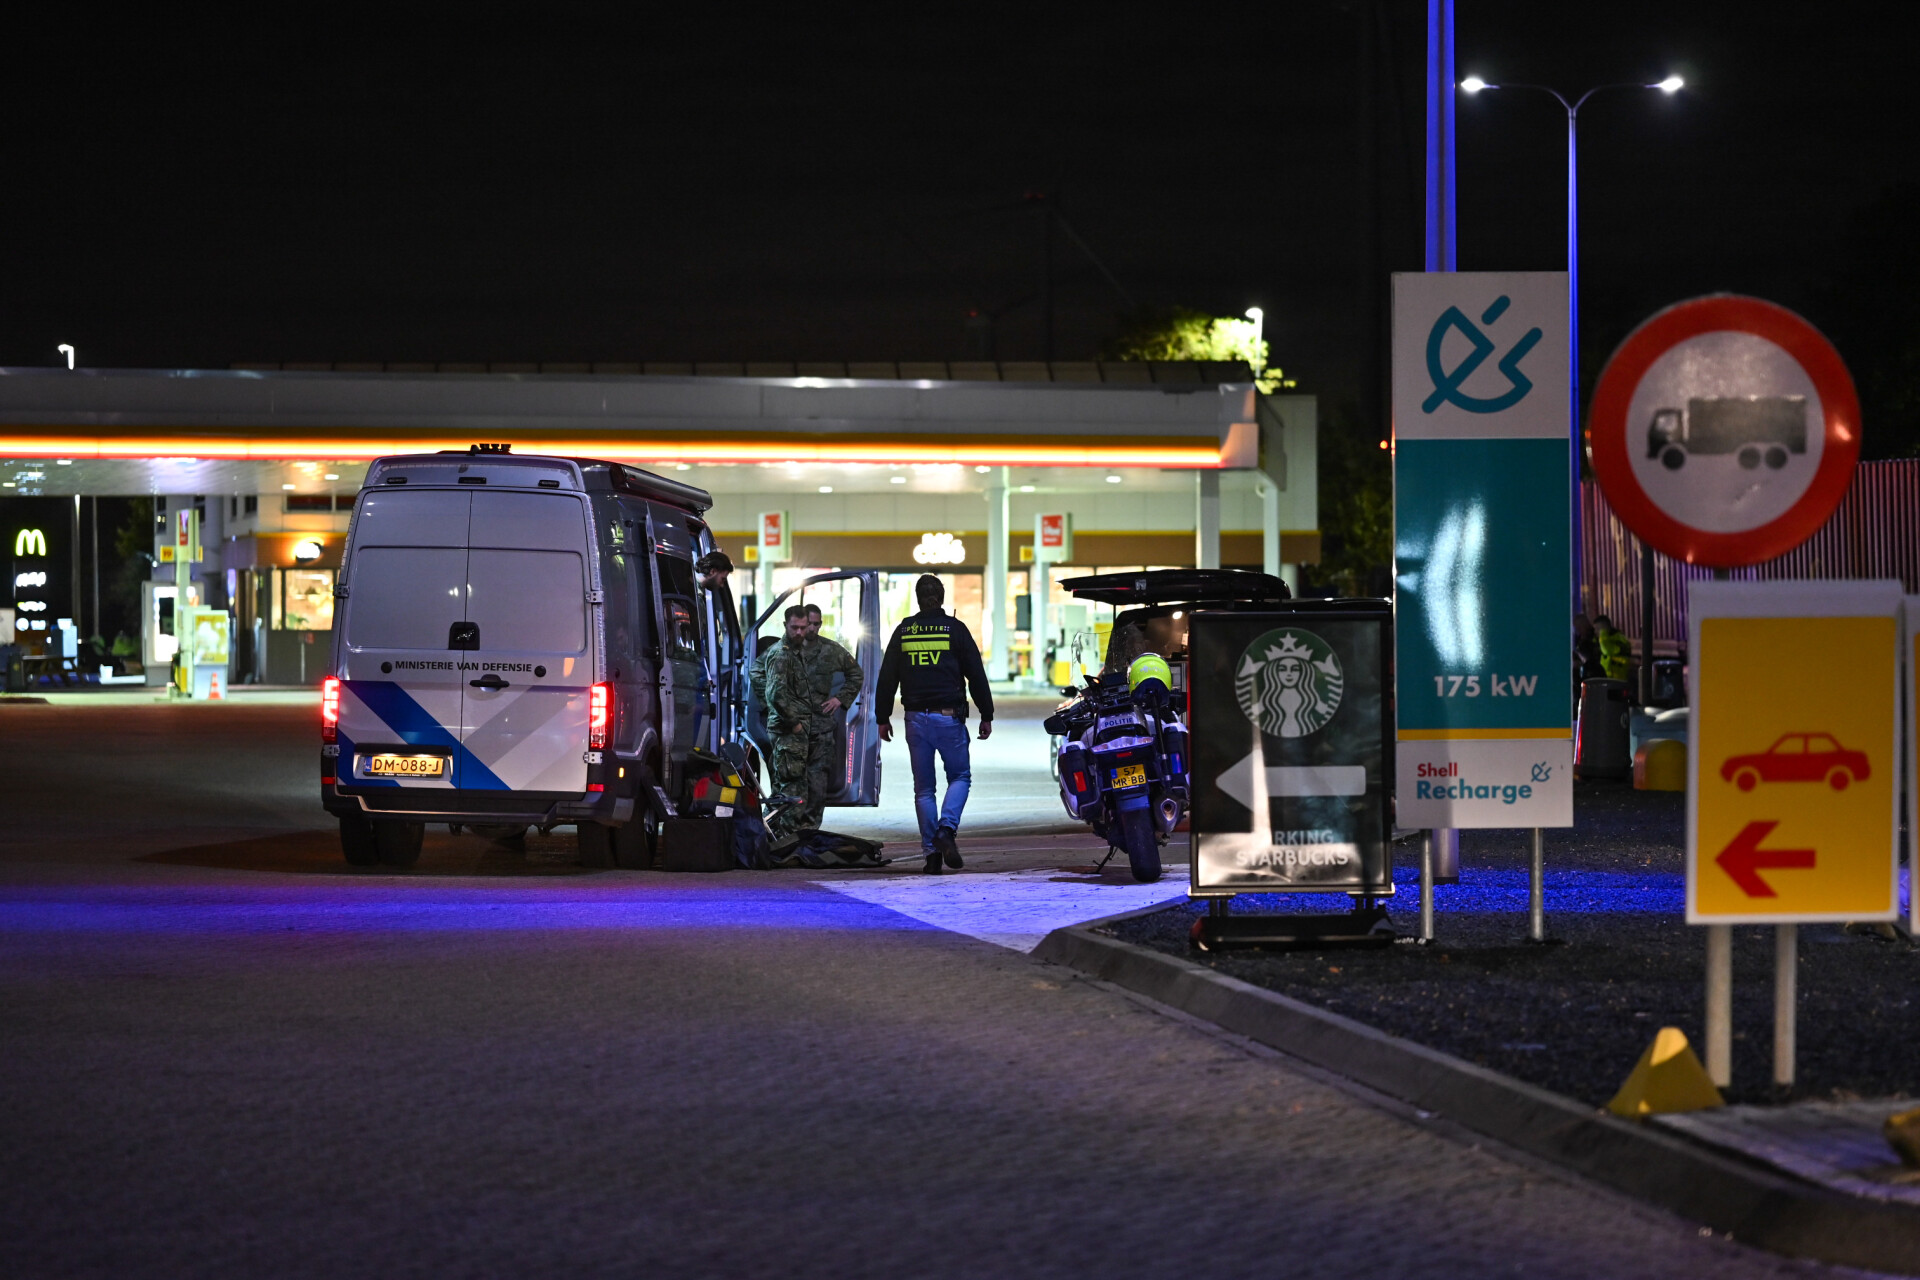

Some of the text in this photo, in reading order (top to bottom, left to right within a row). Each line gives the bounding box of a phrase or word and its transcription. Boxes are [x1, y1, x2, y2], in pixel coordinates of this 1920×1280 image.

[395, 660, 532, 673] MINISTERIE VAN DEFENSIE
[908, 651, 941, 666] TEV
[1434, 673, 1538, 698] 175 kW
[374, 758, 440, 773] DM-088-J
[1123, 767, 1136, 775] 57
[1417, 762, 1458, 778] Shell
[1416, 778, 1533, 805] Recharge
[1273, 829, 1335, 846] RKING
[1235, 849, 1350, 867] STARBUCKS
